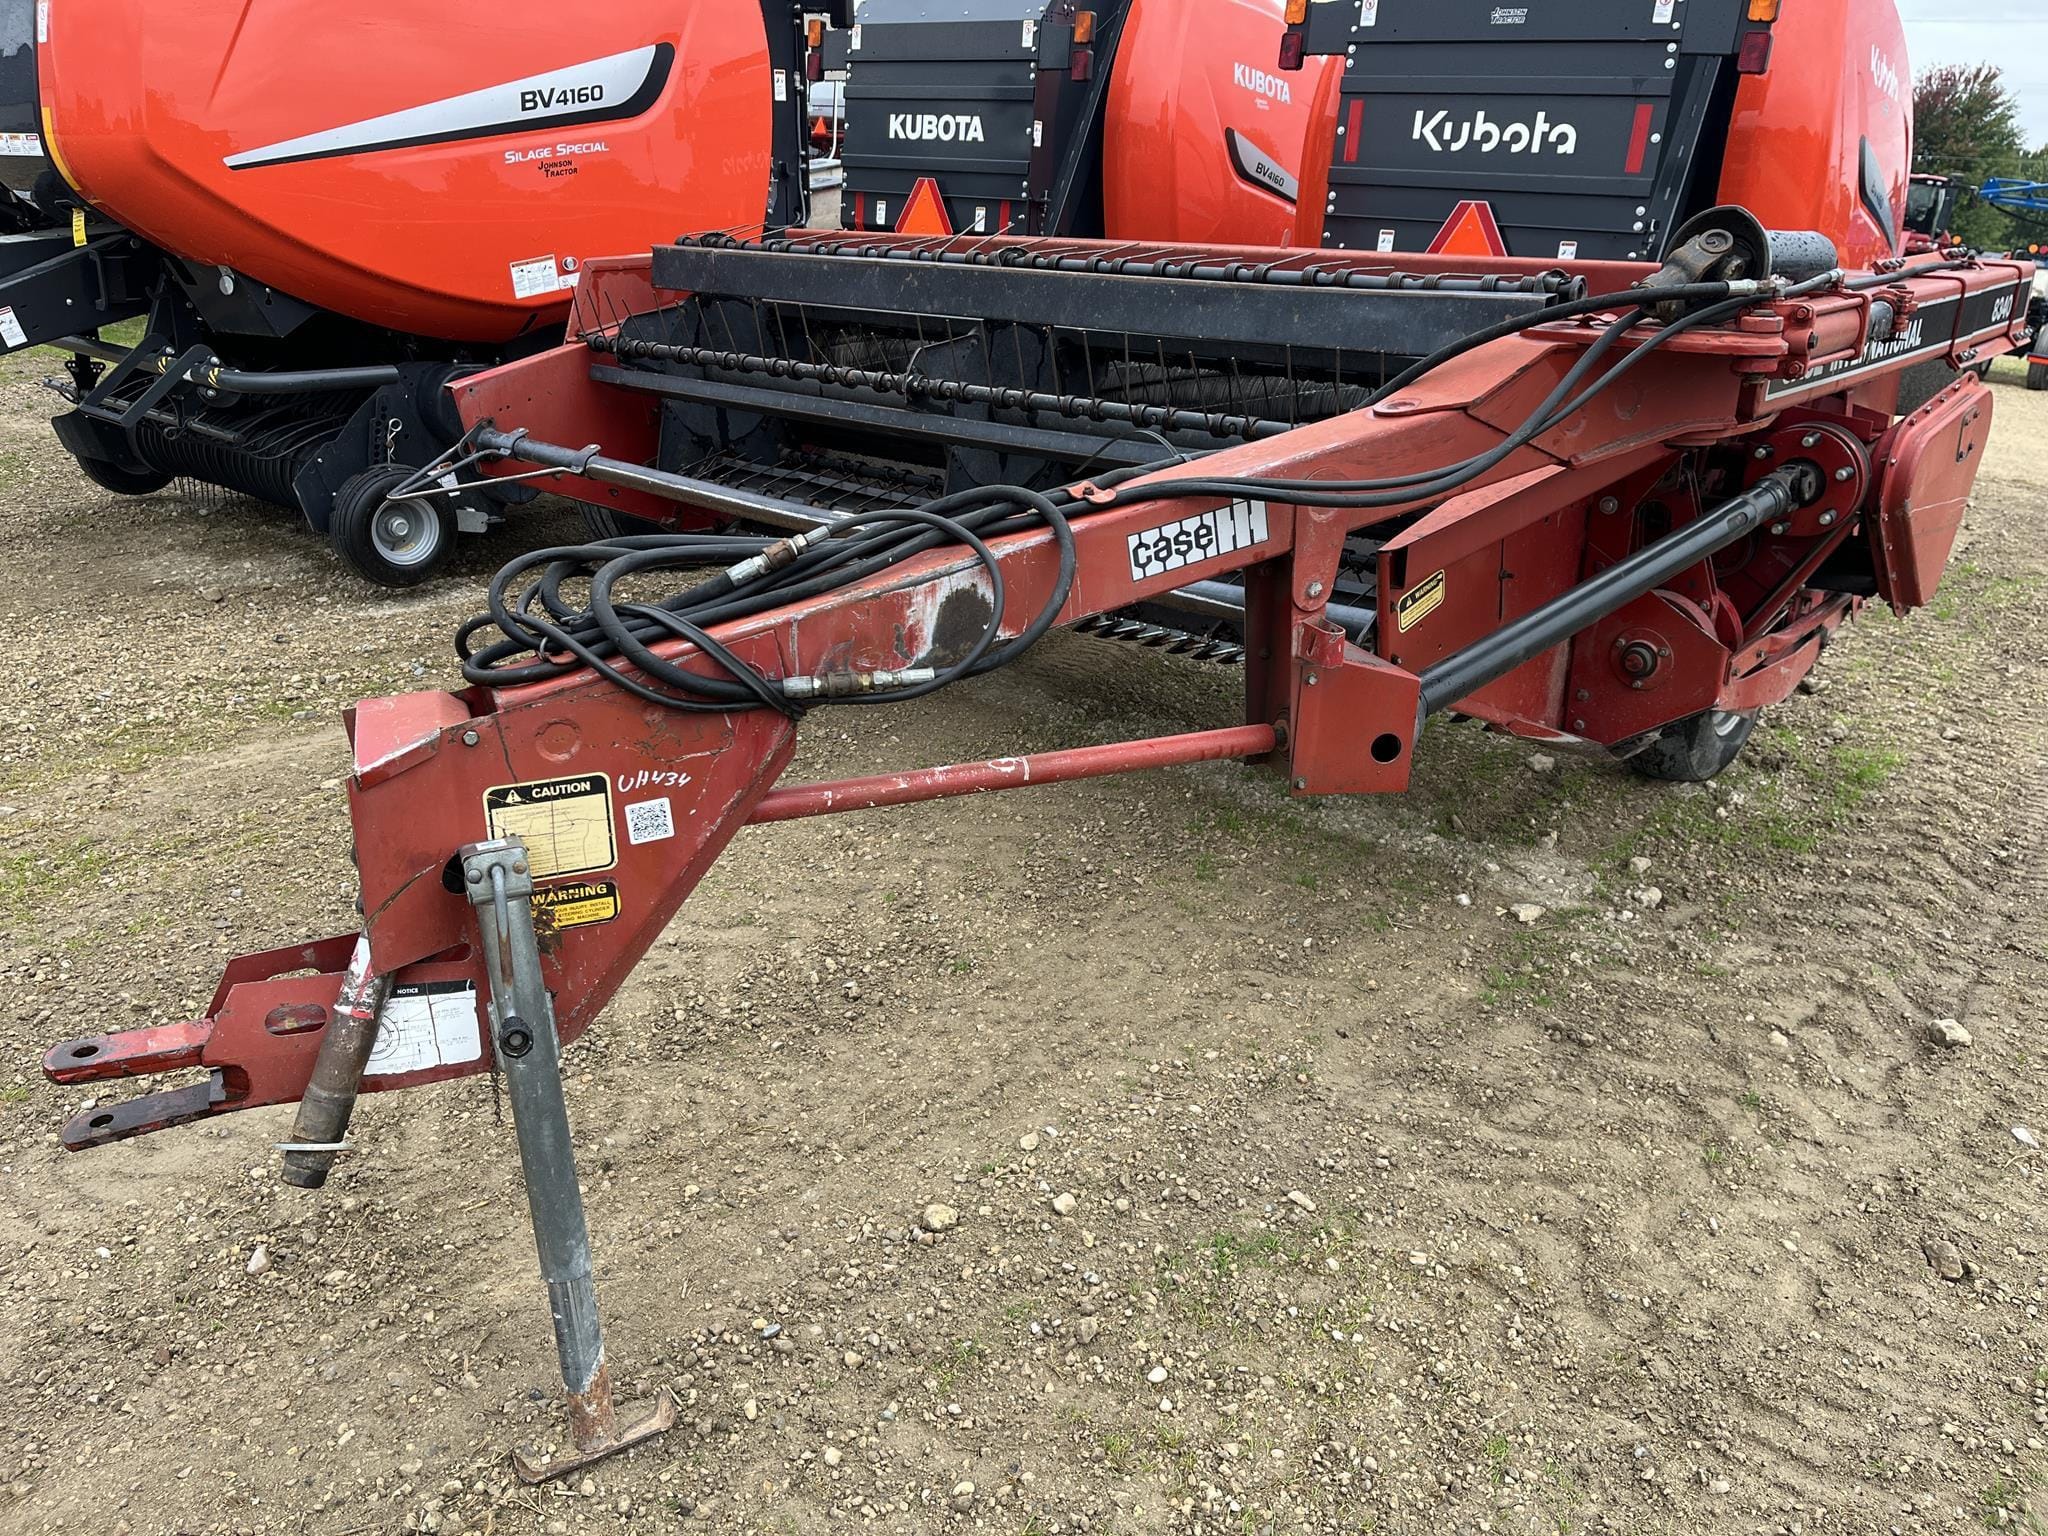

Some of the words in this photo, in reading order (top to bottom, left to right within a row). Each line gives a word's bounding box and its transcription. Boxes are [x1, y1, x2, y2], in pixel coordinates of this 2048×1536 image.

[1233, 62, 1291, 105] KUBOTA
[520, 84, 604, 112] BV4160
[889, 113, 985, 142] KUBOTA
[1412, 110, 1577, 154] Kubota
[538, 160, 573, 170] JOHNSON
[544, 168, 578, 178] TRACTOR
[1256, 162, 1285, 187] BV4160
[531, 781, 591, 799] CAUTION
[531, 884, 607, 905] WARNING
[396, 987, 419, 995] NOTICE
